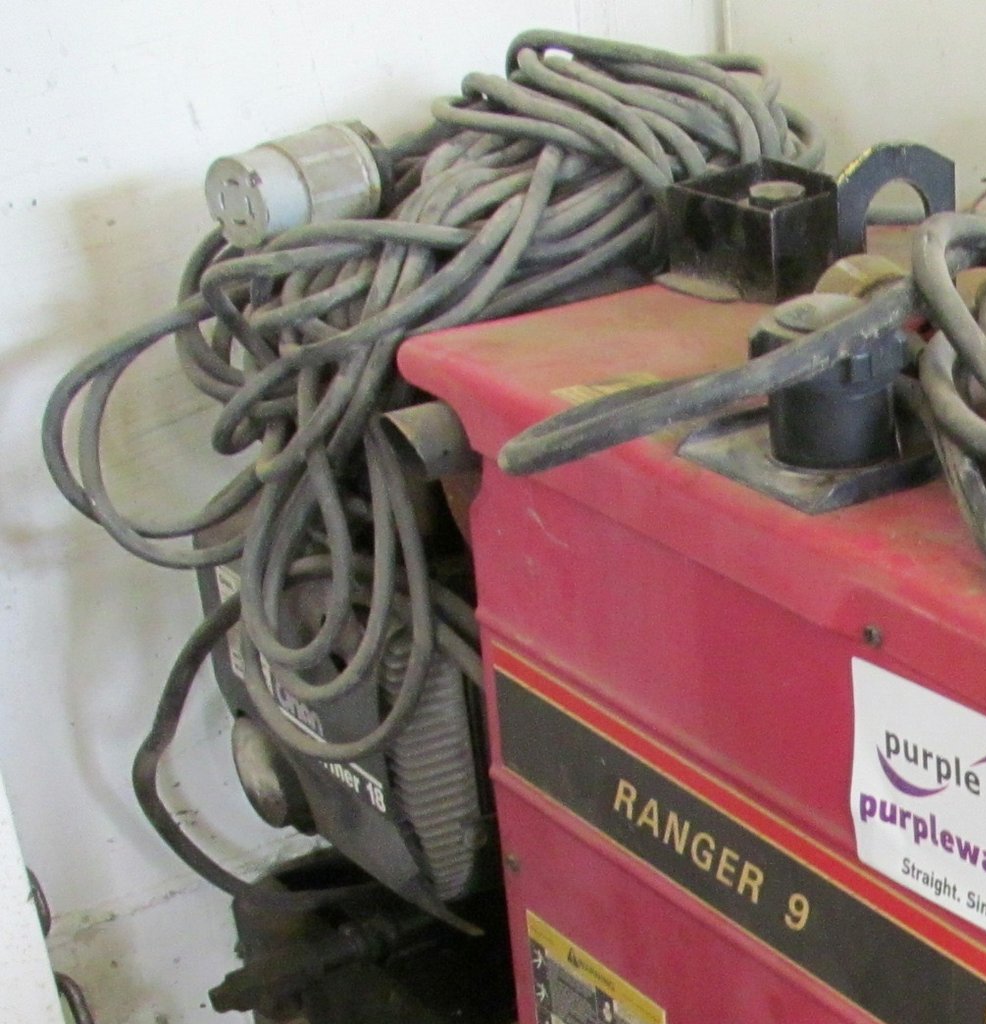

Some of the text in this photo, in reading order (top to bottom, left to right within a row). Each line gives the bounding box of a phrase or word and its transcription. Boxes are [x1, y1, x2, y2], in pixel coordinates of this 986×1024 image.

[885, 729, 981, 796] purple
[365, 781, 387, 813] 18
[612, 778, 811, 931] RANGER 9
[901, 857, 961, 903] Straight.
